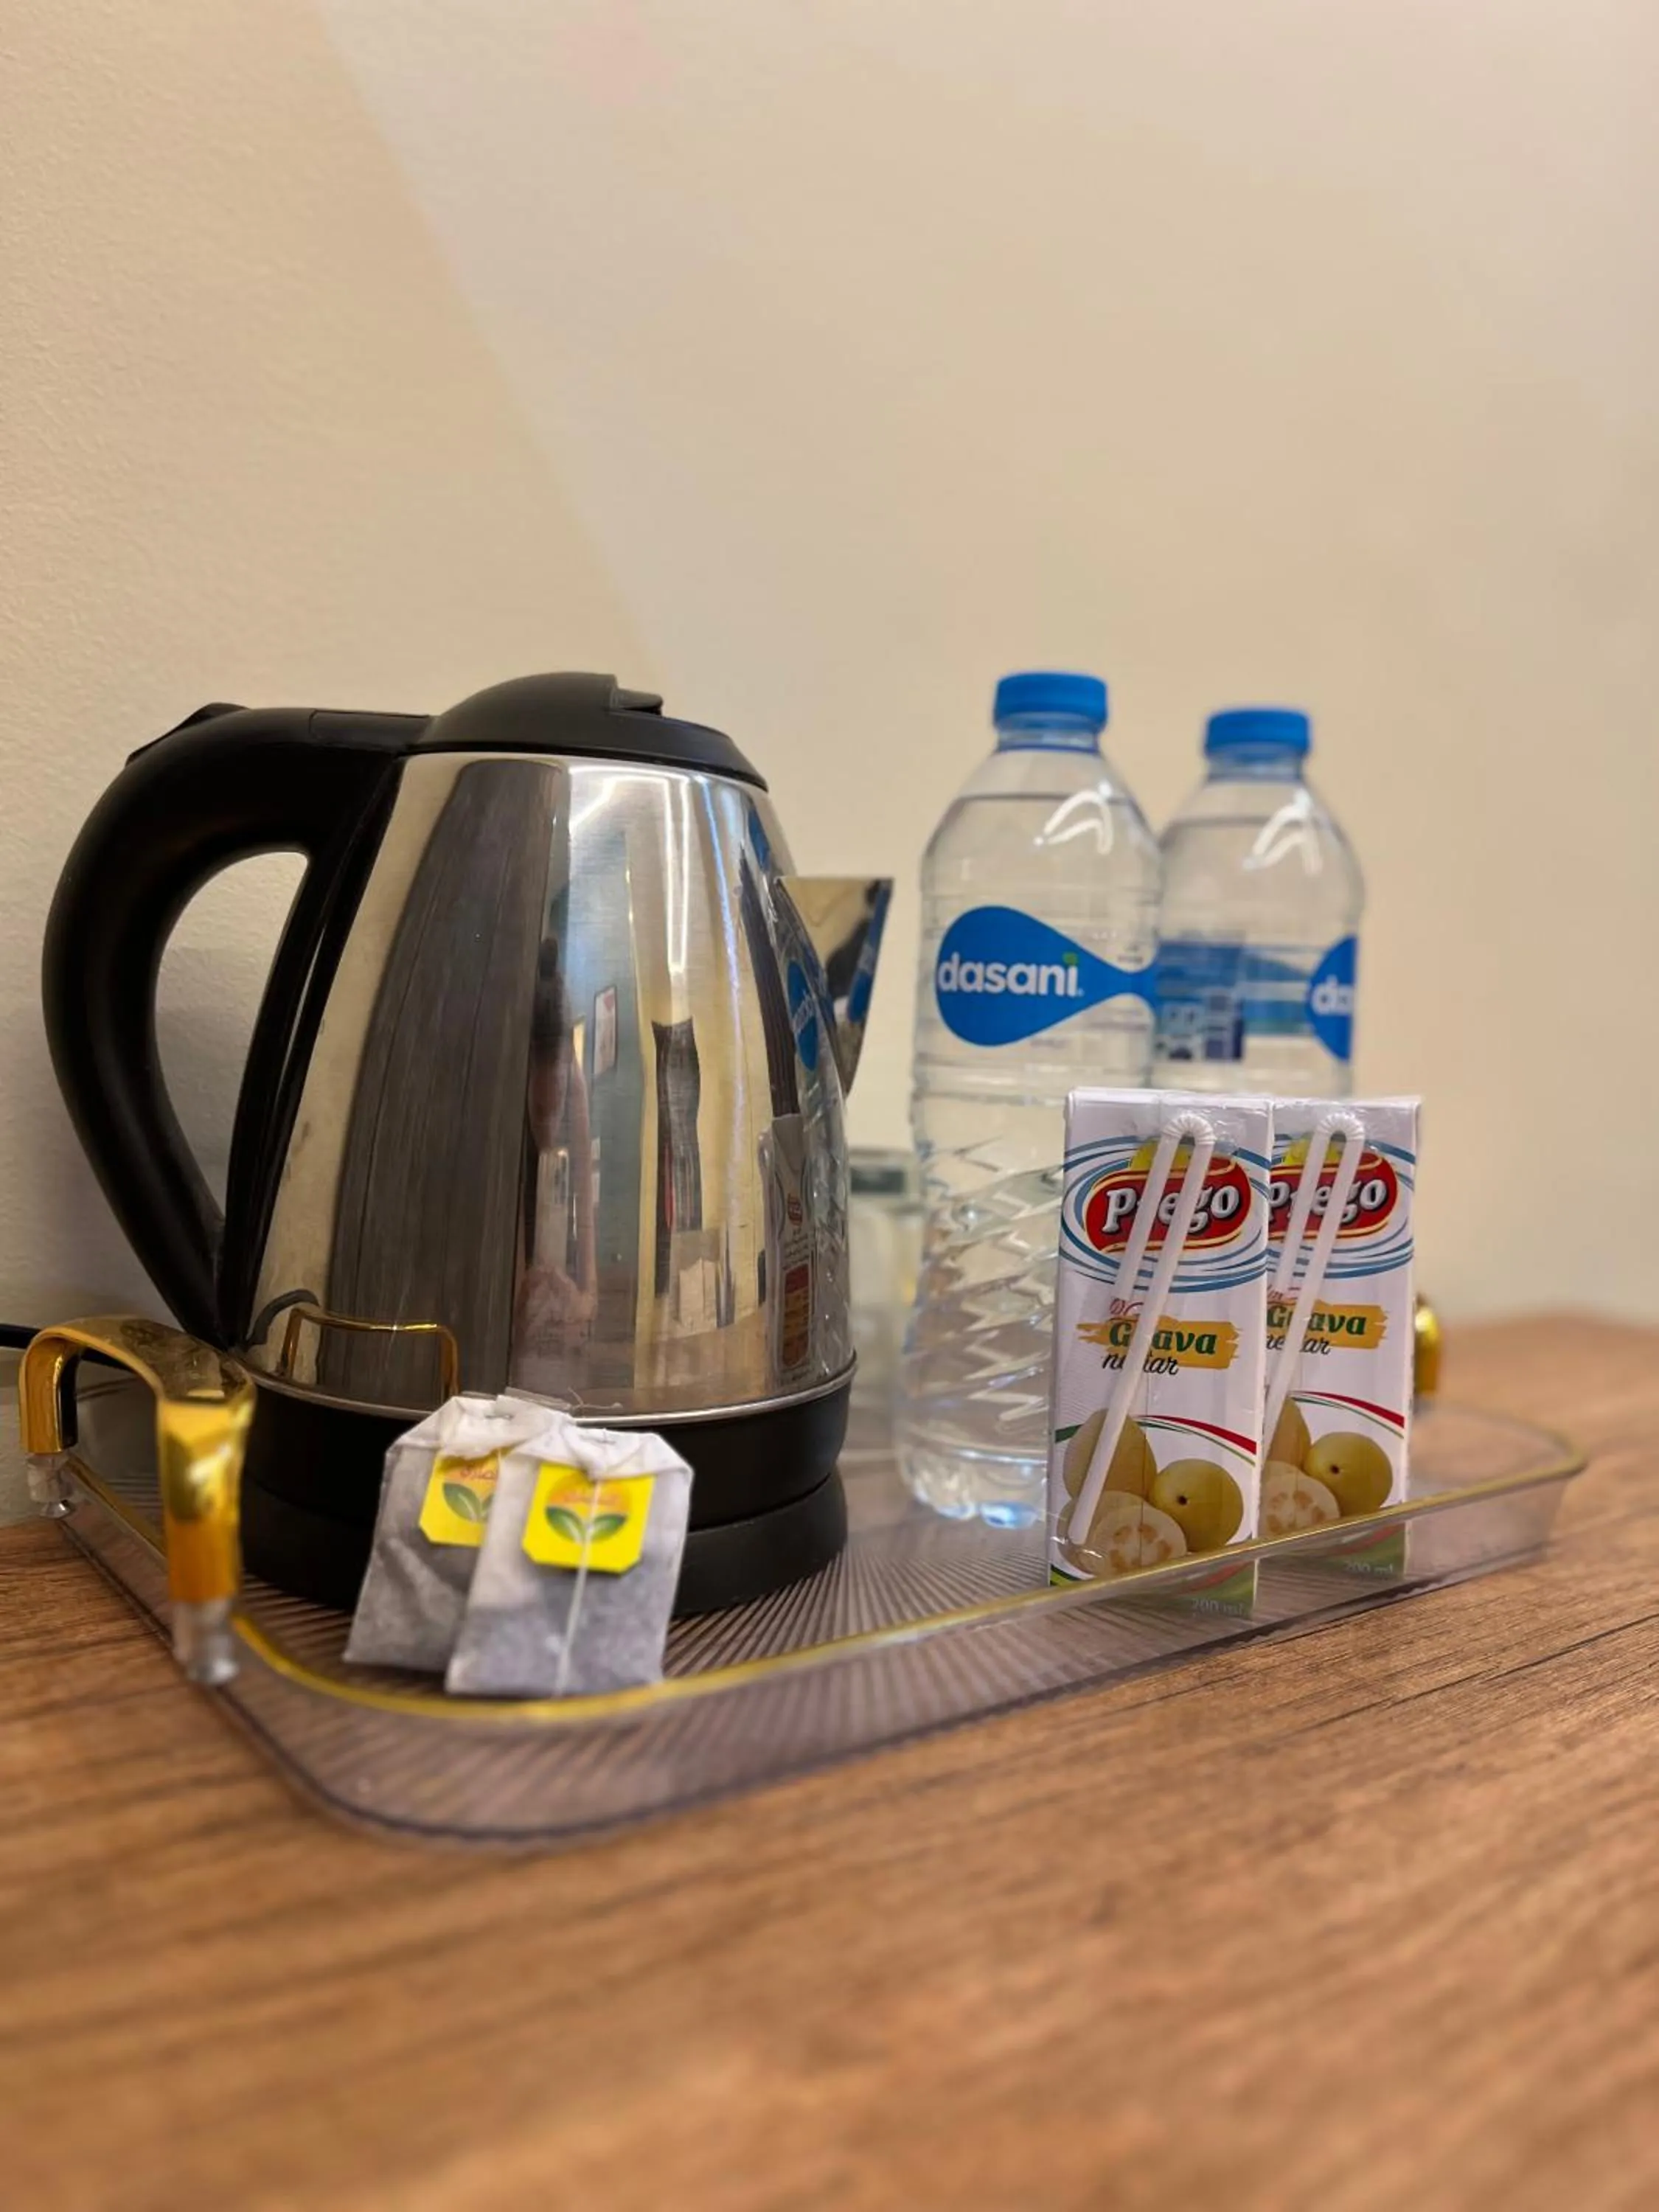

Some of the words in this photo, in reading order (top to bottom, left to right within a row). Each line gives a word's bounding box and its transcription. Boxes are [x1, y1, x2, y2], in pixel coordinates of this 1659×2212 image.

[938, 951, 1079, 997] dasani
[1102, 1185, 1239, 1234] Pego
[1109, 1321, 1217, 1355] Gava
[1267, 1305, 1366, 1335] Gava
